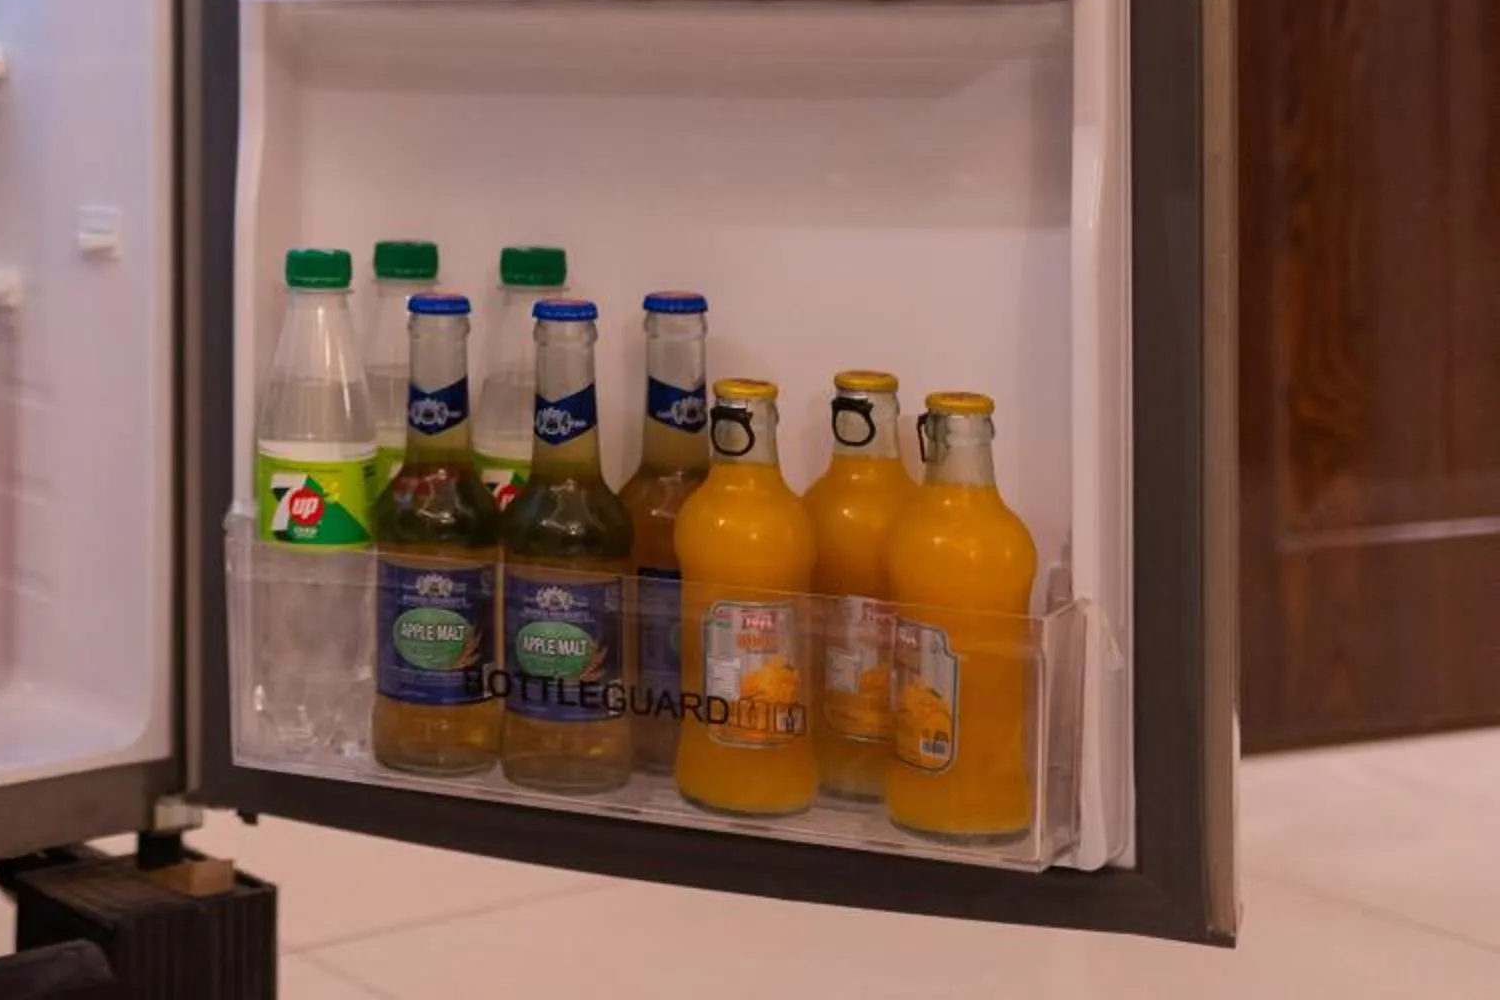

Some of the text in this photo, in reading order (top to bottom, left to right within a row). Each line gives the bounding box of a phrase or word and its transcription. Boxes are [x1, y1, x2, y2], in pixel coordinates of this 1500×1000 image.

[402, 622, 465, 641] APPLE MALT
[523, 636, 588, 657] APPLE MALT
[463, 668, 729, 725] BOTTLEGUARD
